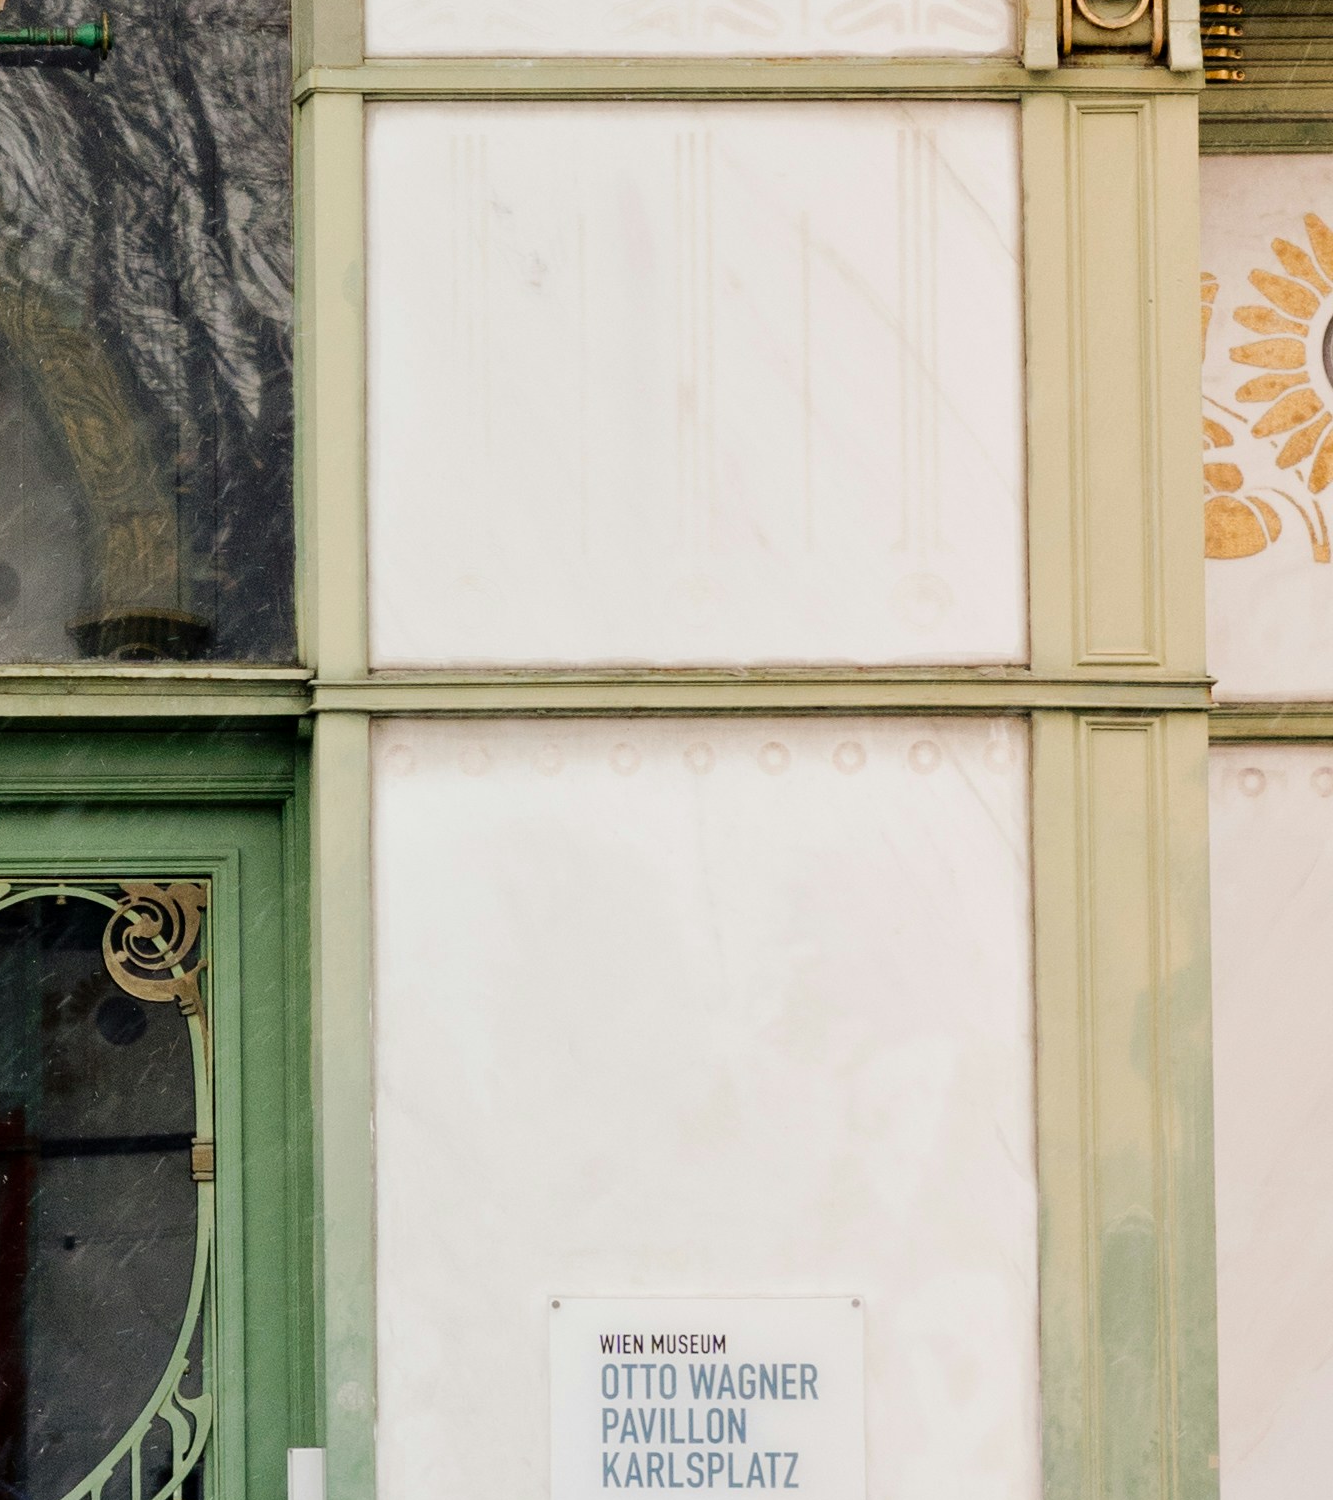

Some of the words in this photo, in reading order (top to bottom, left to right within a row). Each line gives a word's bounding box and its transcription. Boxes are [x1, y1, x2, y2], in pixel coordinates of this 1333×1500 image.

[599, 1334, 645, 1355] WIEN
[650, 1334, 727, 1355] MUSEUM
[600, 1363, 677, 1400] OTTO
[688, 1363, 820, 1400] WAGNER
[601, 1407, 747, 1444] PAVILLON
[601, 1452, 800, 1488] KARLSPLATZ
